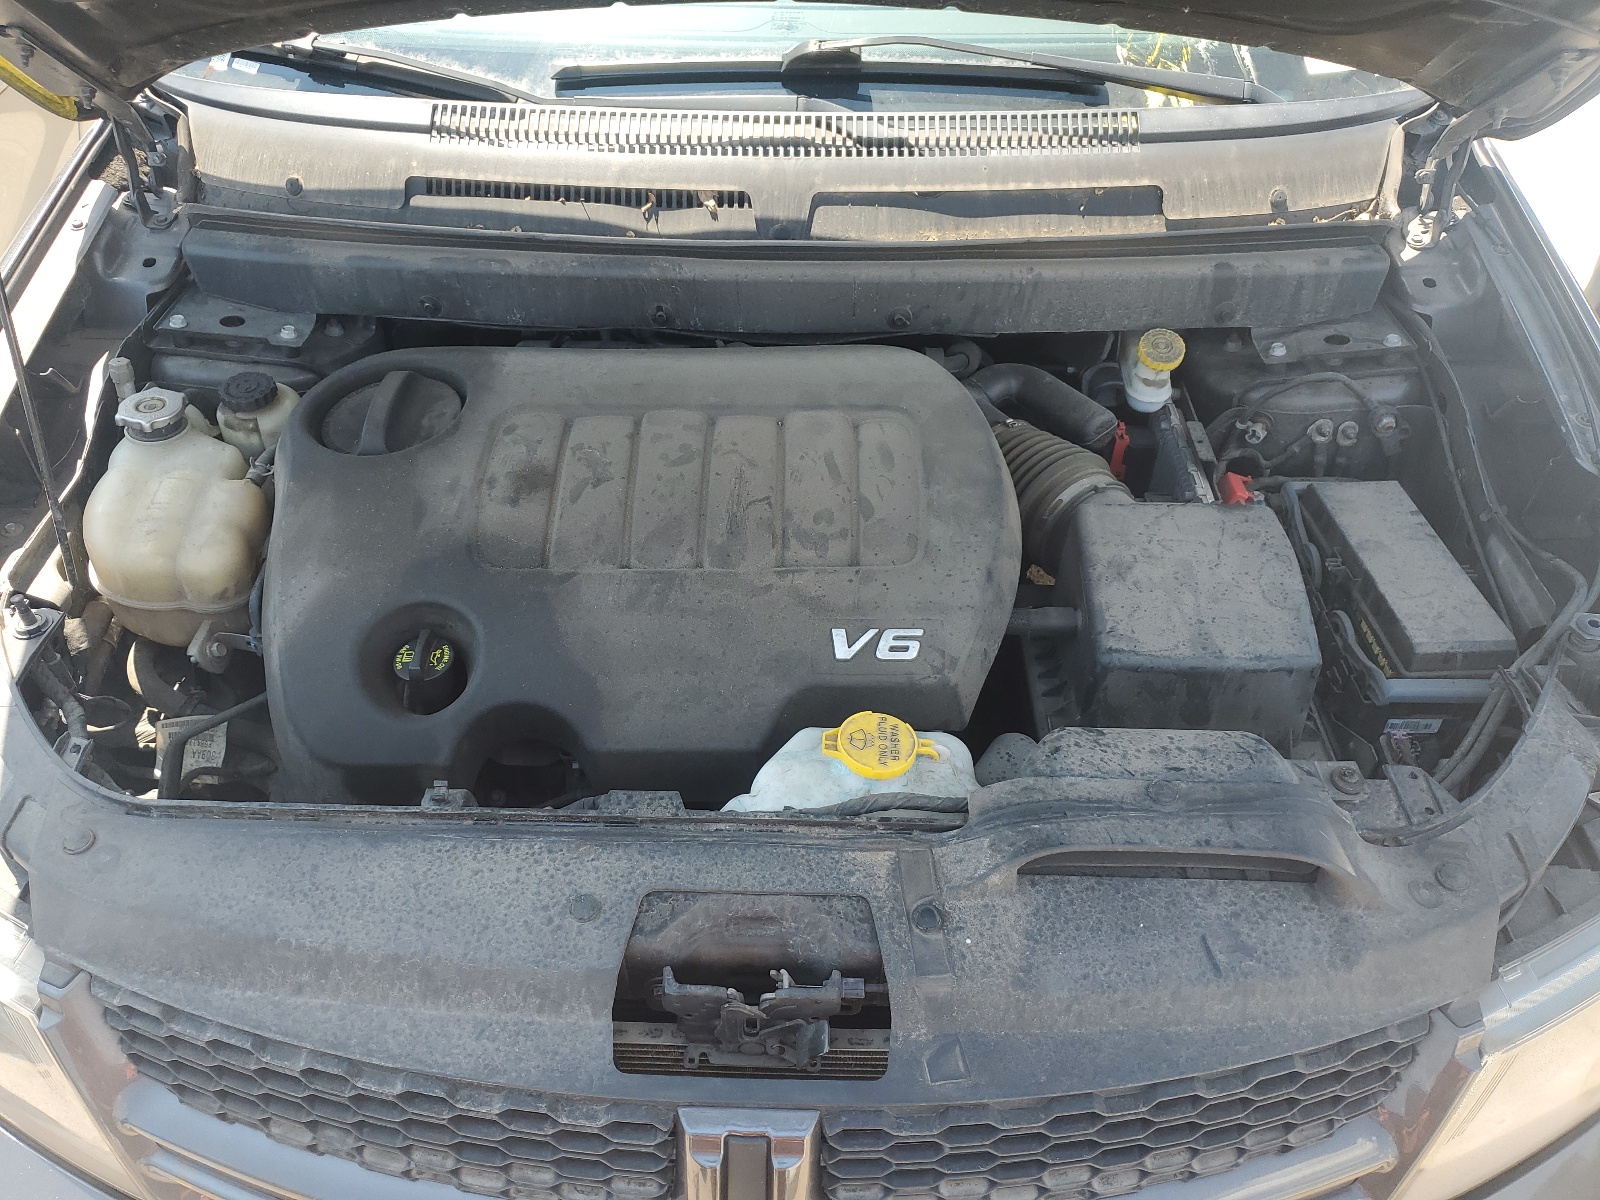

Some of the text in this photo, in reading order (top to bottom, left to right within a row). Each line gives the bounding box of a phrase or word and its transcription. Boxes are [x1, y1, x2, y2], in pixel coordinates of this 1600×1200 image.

[831, 628, 924, 660] V6
[877, 716, 888, 767] FLUID ONLY
[889, 723, 900, 762] WASHER
